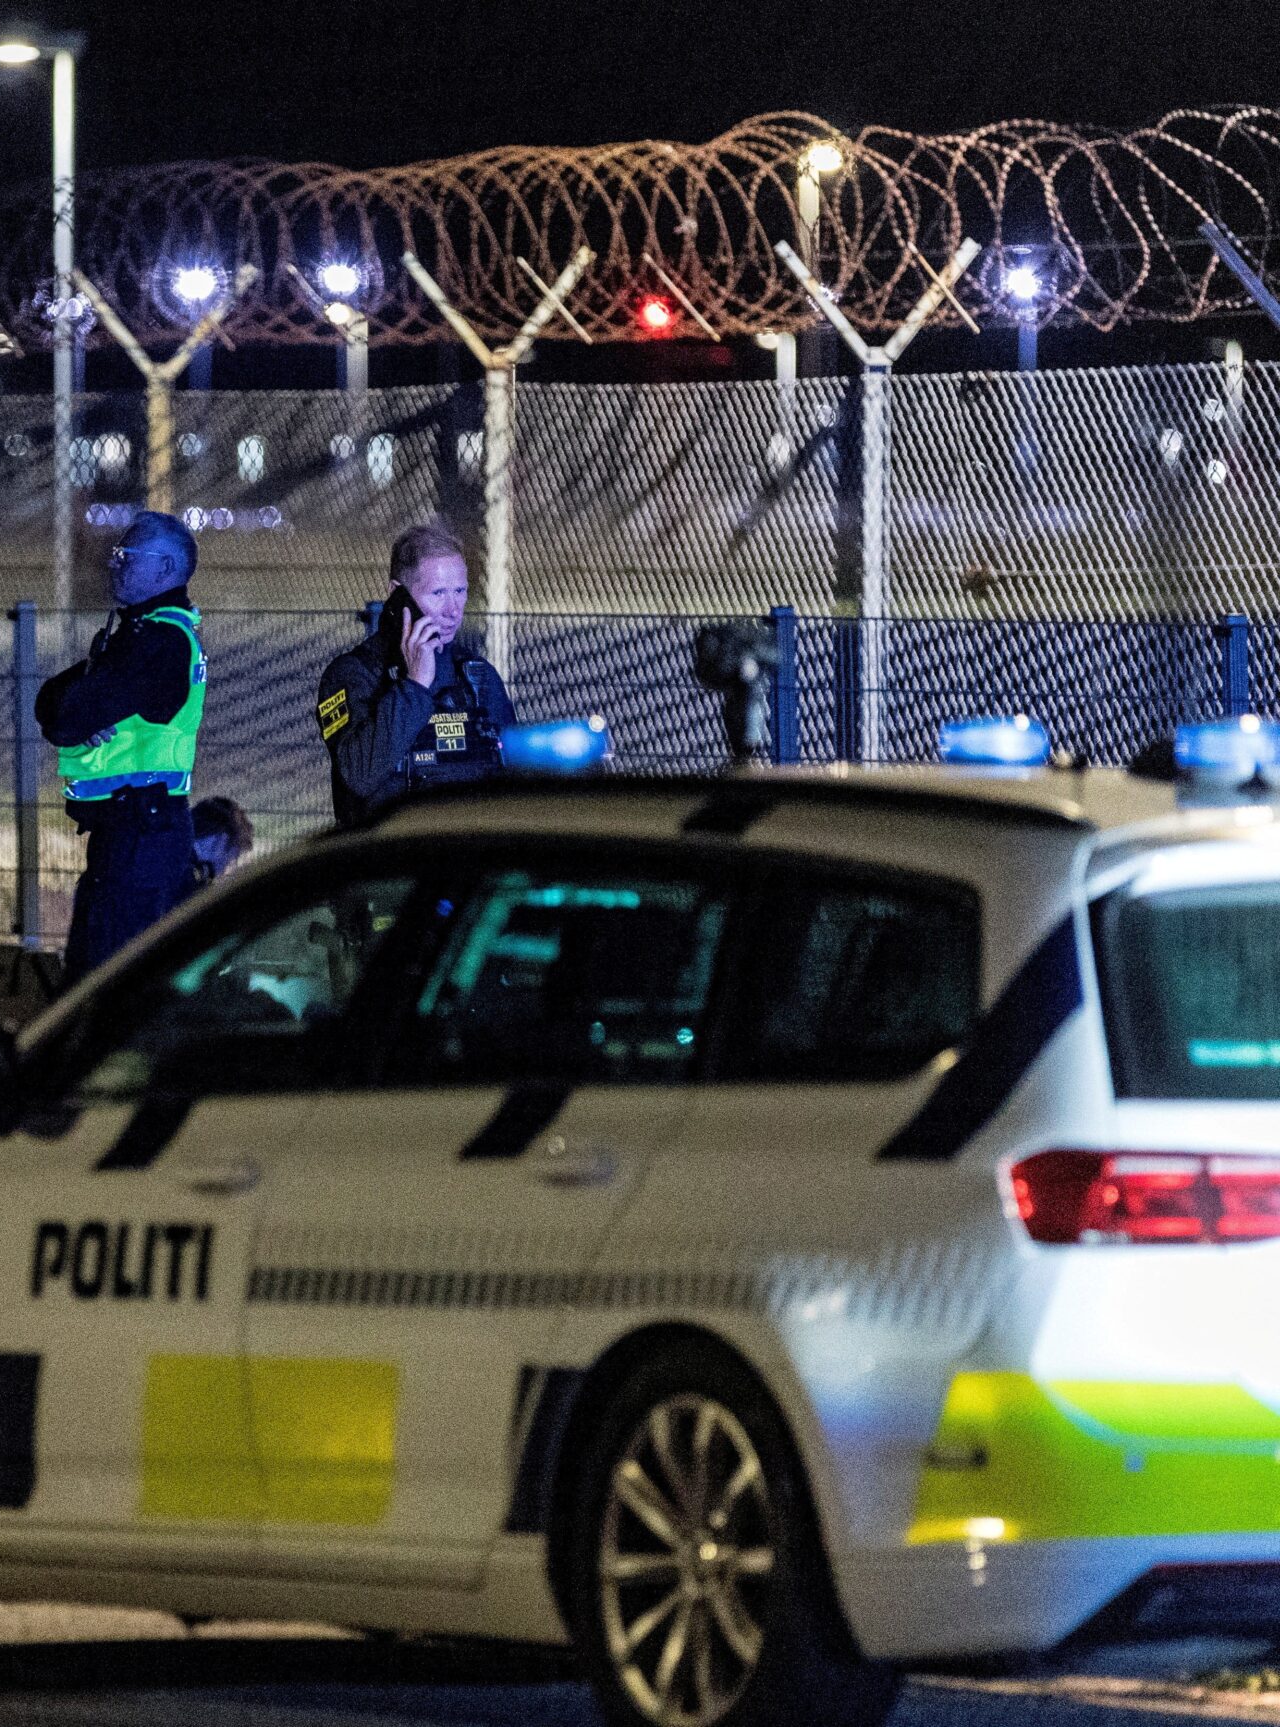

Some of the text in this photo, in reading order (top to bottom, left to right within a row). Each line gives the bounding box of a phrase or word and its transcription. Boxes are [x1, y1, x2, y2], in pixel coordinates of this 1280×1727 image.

[320, 691, 345, 712] POLITI
[428, 712, 469, 724] DSATSLEDER
[437, 724, 464, 736] POLITI
[445, 739, 458, 750] 11
[30, 1221, 213, 1299] POLITI
